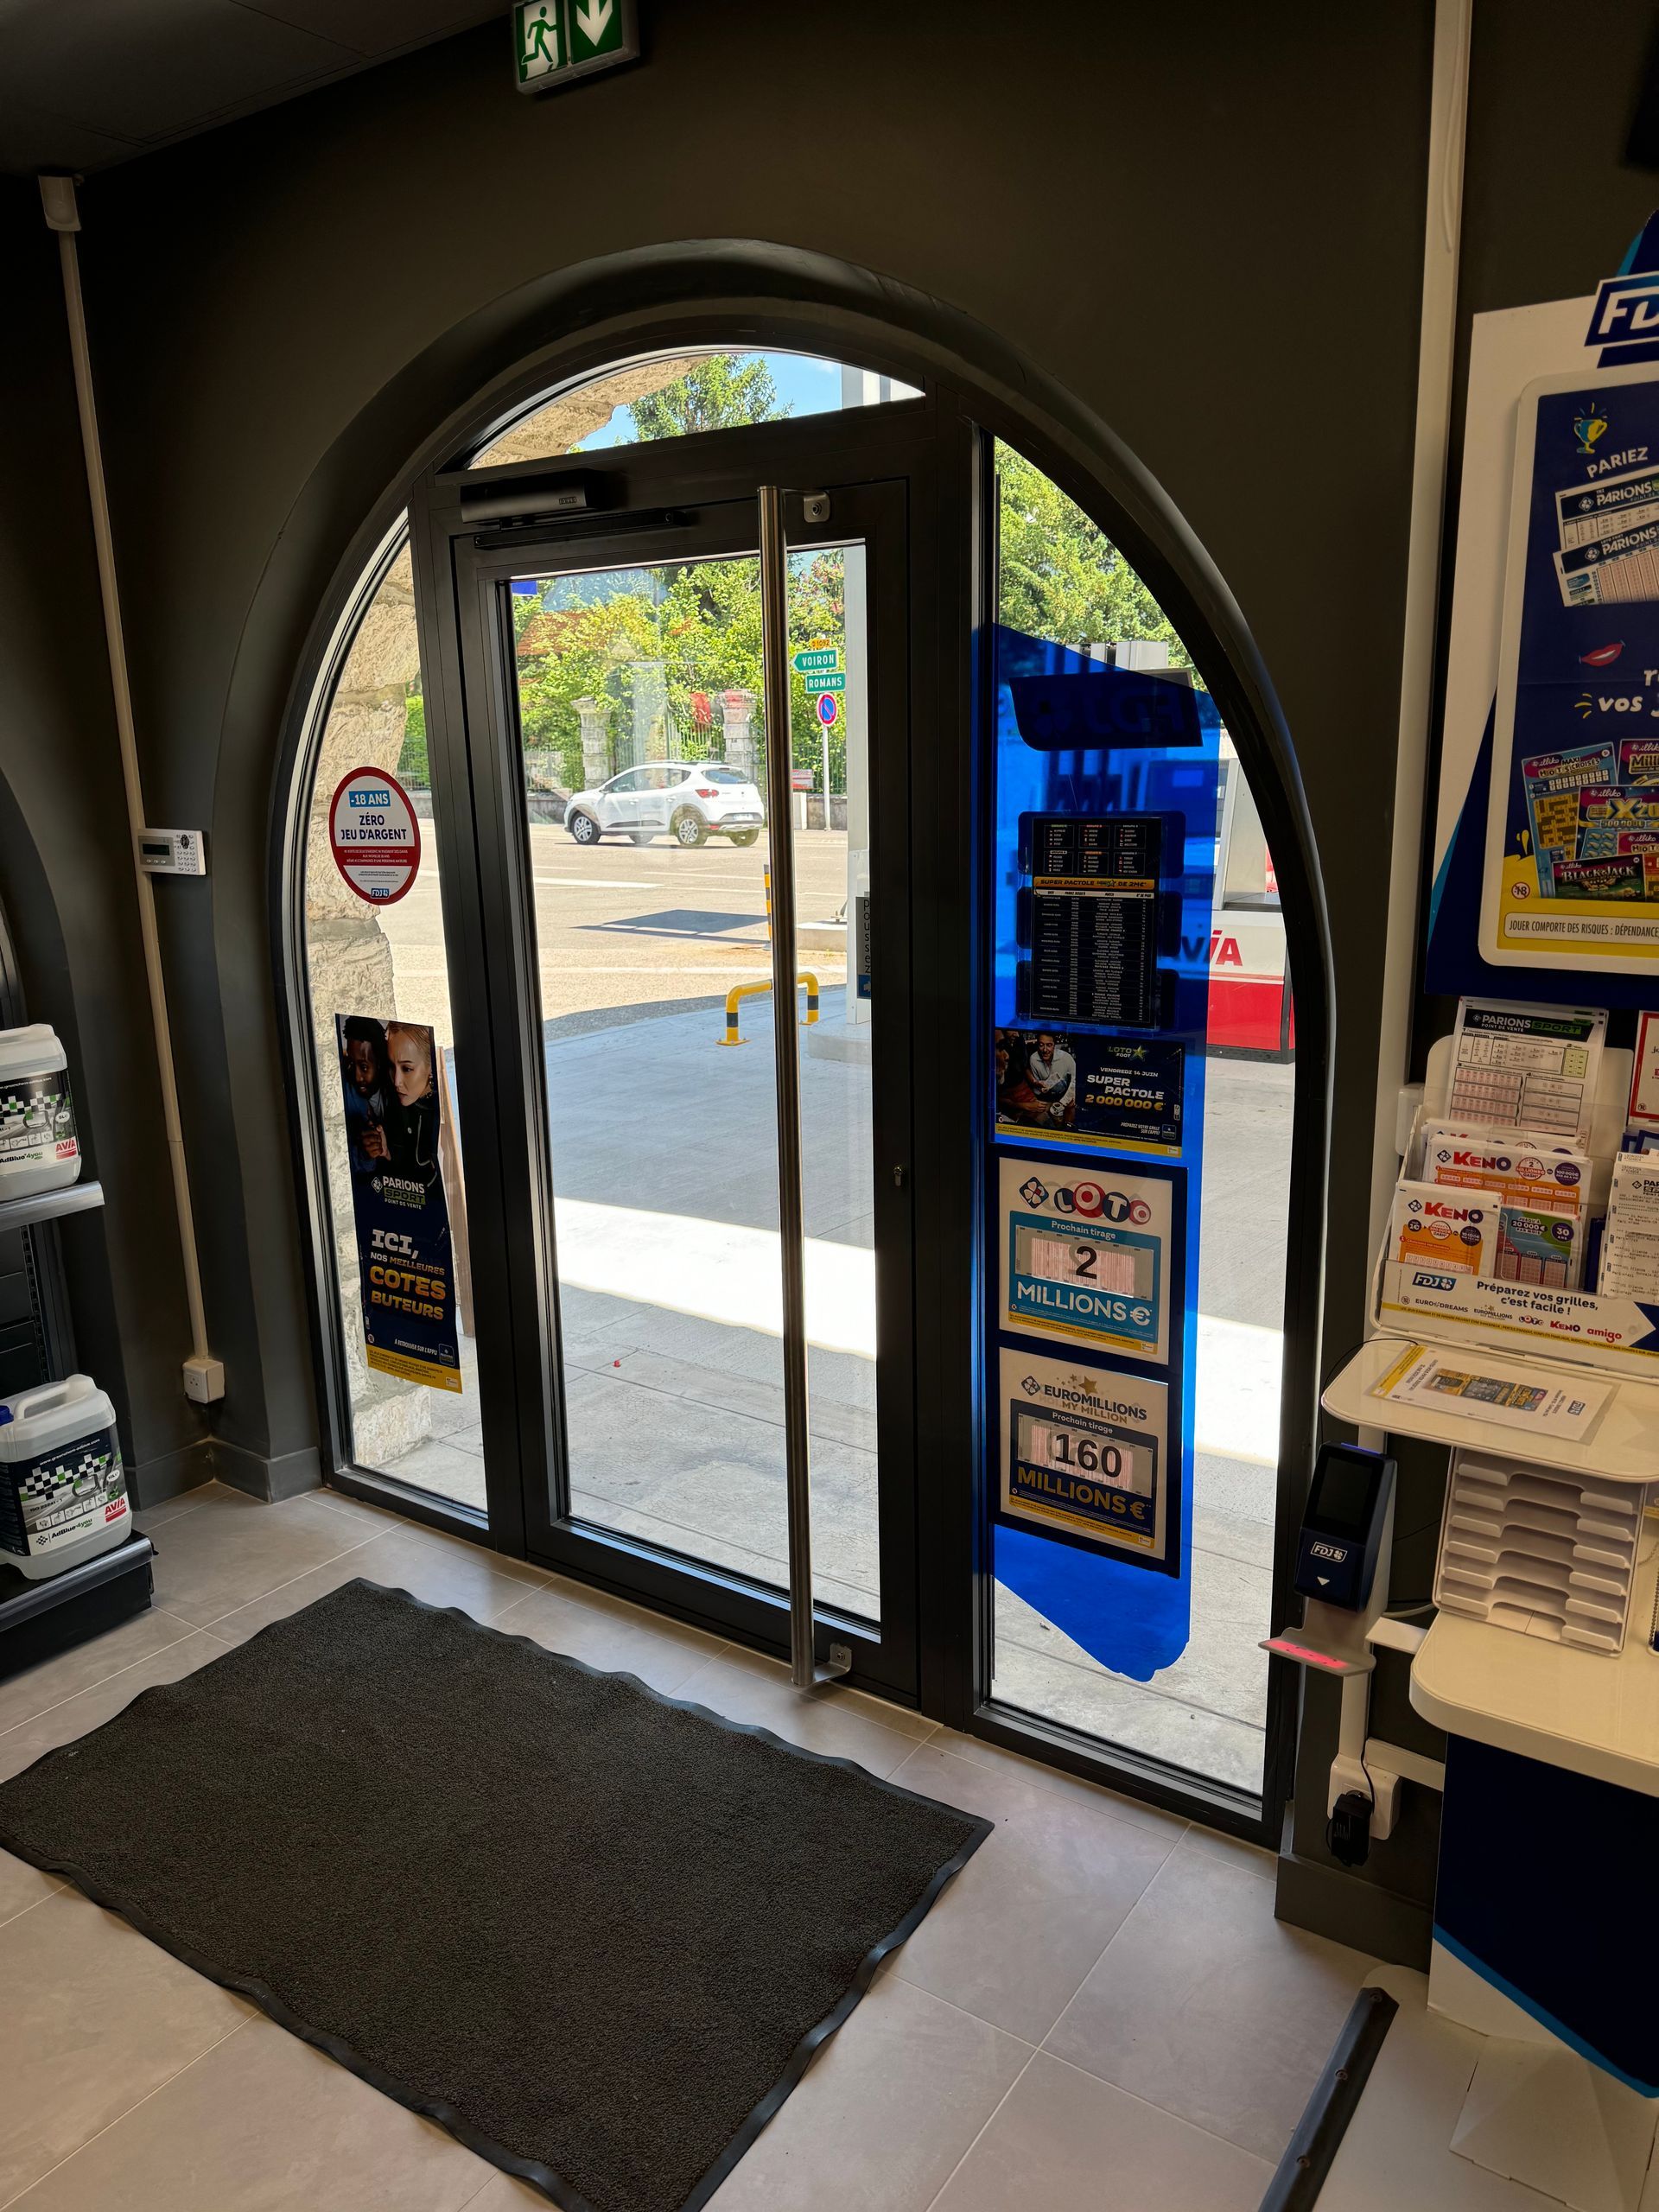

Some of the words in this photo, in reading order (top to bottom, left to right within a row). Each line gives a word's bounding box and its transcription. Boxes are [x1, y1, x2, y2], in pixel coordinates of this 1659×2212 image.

[1586, 447, 1649, 479] PARIEZ
[1596, 481, 1652, 506] PARIONS
[1602, 527, 1657, 556] PARIONS
[802, 654, 835, 667] VOIRON
[808, 677, 842, 689] ROMANS
[1598, 696, 1643, 712] vos
[1562, 757, 1580, 766] MAXI
[368, 793, 388, 805] ANS
[359, 812, 385, 825] ZÉRO
[341, 830, 357, 840] JEU
[359, 829, 406, 840] D'ARGENT
[372, 889, 383, 898] FDJ
[1510, 920, 1529, 931] JOUER
[1532, 921, 1566, 932] COMPORTE
[1567, 922, 1580, 933] DES
[1581, 922, 1609, 935] RISQUES
[1181, 930, 1243, 967] VIA
[1482, 1014, 1531, 1029] PARIONS
[1532, 1020, 1581, 1034] SPORT
[1087, 1074, 1131, 1087] SUPER
[1104, 1085, 1164, 1100] PACTOLE
[1085, 1095, 1094, 1103] 2
[1096, 1096, 1123, 1106] 000
[1124, 1098, 1152, 1109] 000
[56, 1139, 76, 1152] AVIA
[1453, 1151, 1511, 1172] KENO
[383, 1175, 424, 1194] PARIONS
[385, 1189, 424, 1204] SPORT
[406, 1201, 422, 1210] VENTE
[1055, 1182, 1151, 1224] LOTO
[1424, 1201, 1484, 1224] KENO
[1052, 1220, 1089, 1235] Prochain
[1090, 1228, 1116, 1241] tirage
[1556, 1228, 1569, 1236] 30
[372, 1229, 418, 1260] ICI,
[371, 1251, 388, 1262] NOS
[390, 1256, 445, 1275] MEILLEURES
[1076, 1246, 1097, 1280] 2
[370, 1266, 446, 1300] COTES
[1415, 1274, 1440, 1287] FDJ
[1477, 1281, 1530, 1298] Préparez
[1533, 1292, 1554, 1301] vos
[1556, 1294, 1599, 1310] grilles,
[371, 1292, 444, 1320] BUTEURS
[1474, 1308, 1513, 1320] EUROMILLIONS
[1500, 1296, 1528, 1308] c'est
[1530, 1300, 1563, 1313] facile
[1567, 1306, 1571, 1315] !
[1550, 1320, 1580, 1332] KENO
[1586, 1328, 1622, 1343] amigo
[1044, 1383, 1147, 1421] EUROMILLIONS
[1062, 1401, 1078, 1411] MY
[1081, 1404, 1127, 1424] MILLION
[1052, 1411, 1087, 1427] Prochain
[1089, 1421, 1113, 1434] tirage
[1055, 1433, 1122, 1478] 160
[105, 1497, 125, 1515] AVIA
[1313, 1545, 1334, 1557] FDJ
